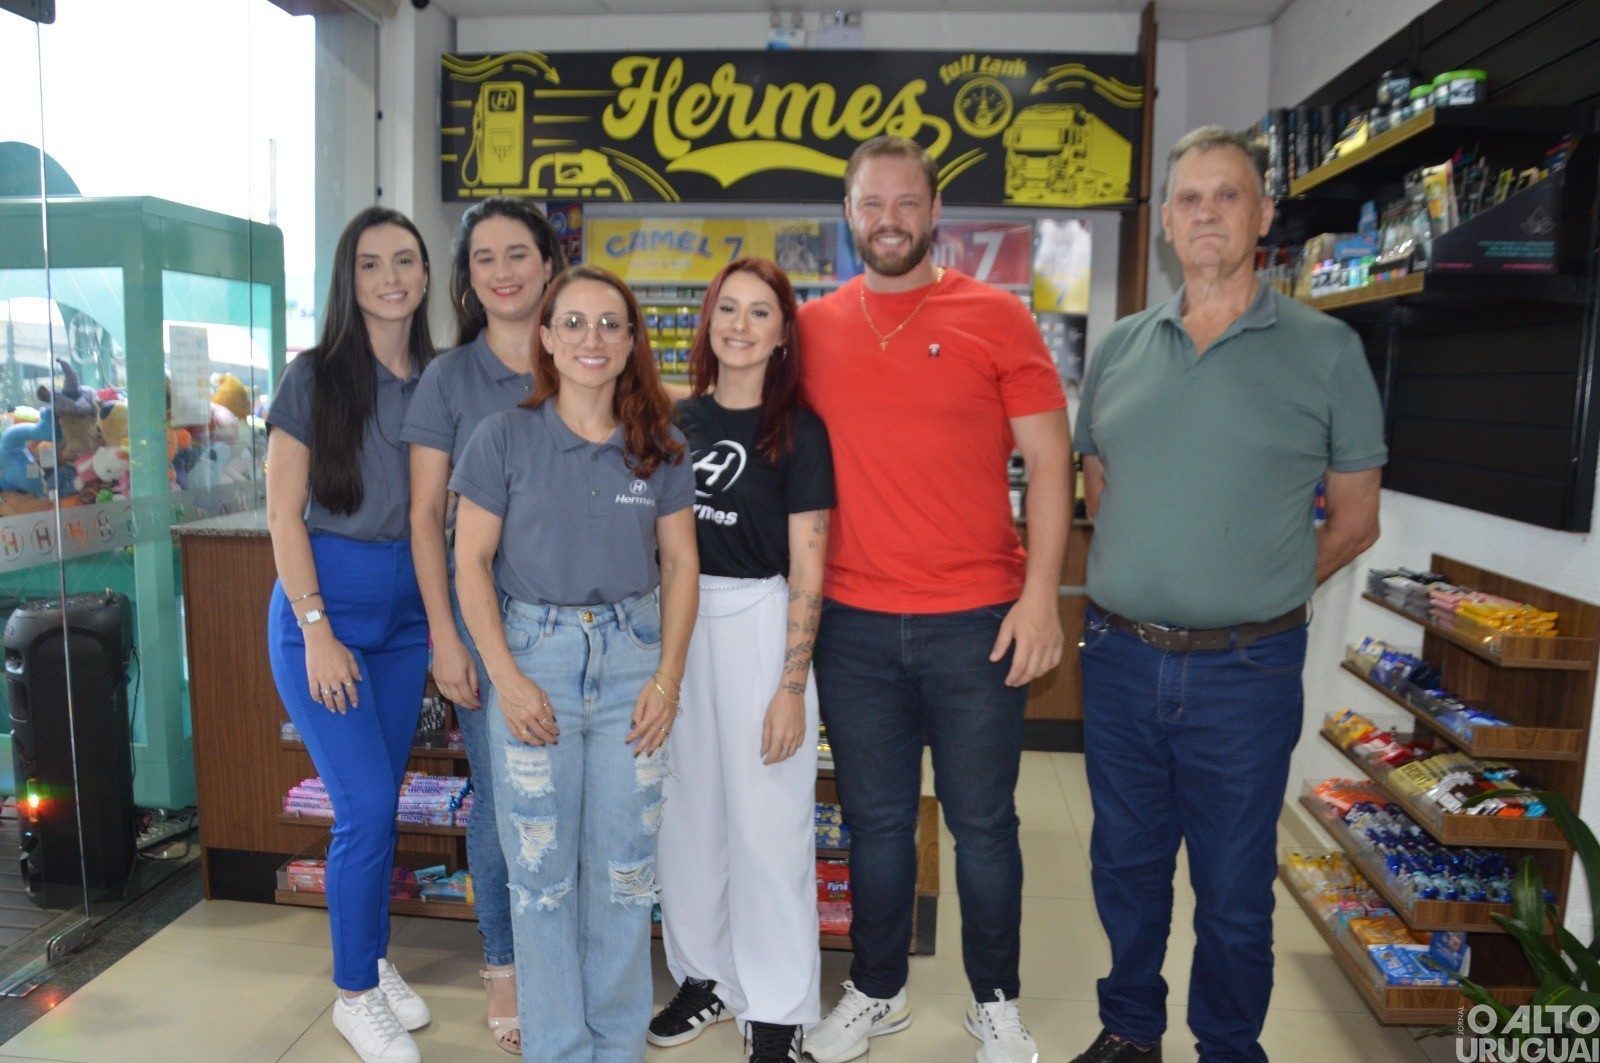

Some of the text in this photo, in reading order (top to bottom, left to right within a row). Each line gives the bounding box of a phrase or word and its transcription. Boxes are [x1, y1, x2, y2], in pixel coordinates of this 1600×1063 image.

[939, 54, 1027, 85] full tank
[602, 56, 952, 160] Hermes
[605, 229, 743, 261] CAMEL 7
[972, 231, 1005, 282] 7
[615, 494, 656, 506] Hermes
[692, 503, 738, 526] rmes
